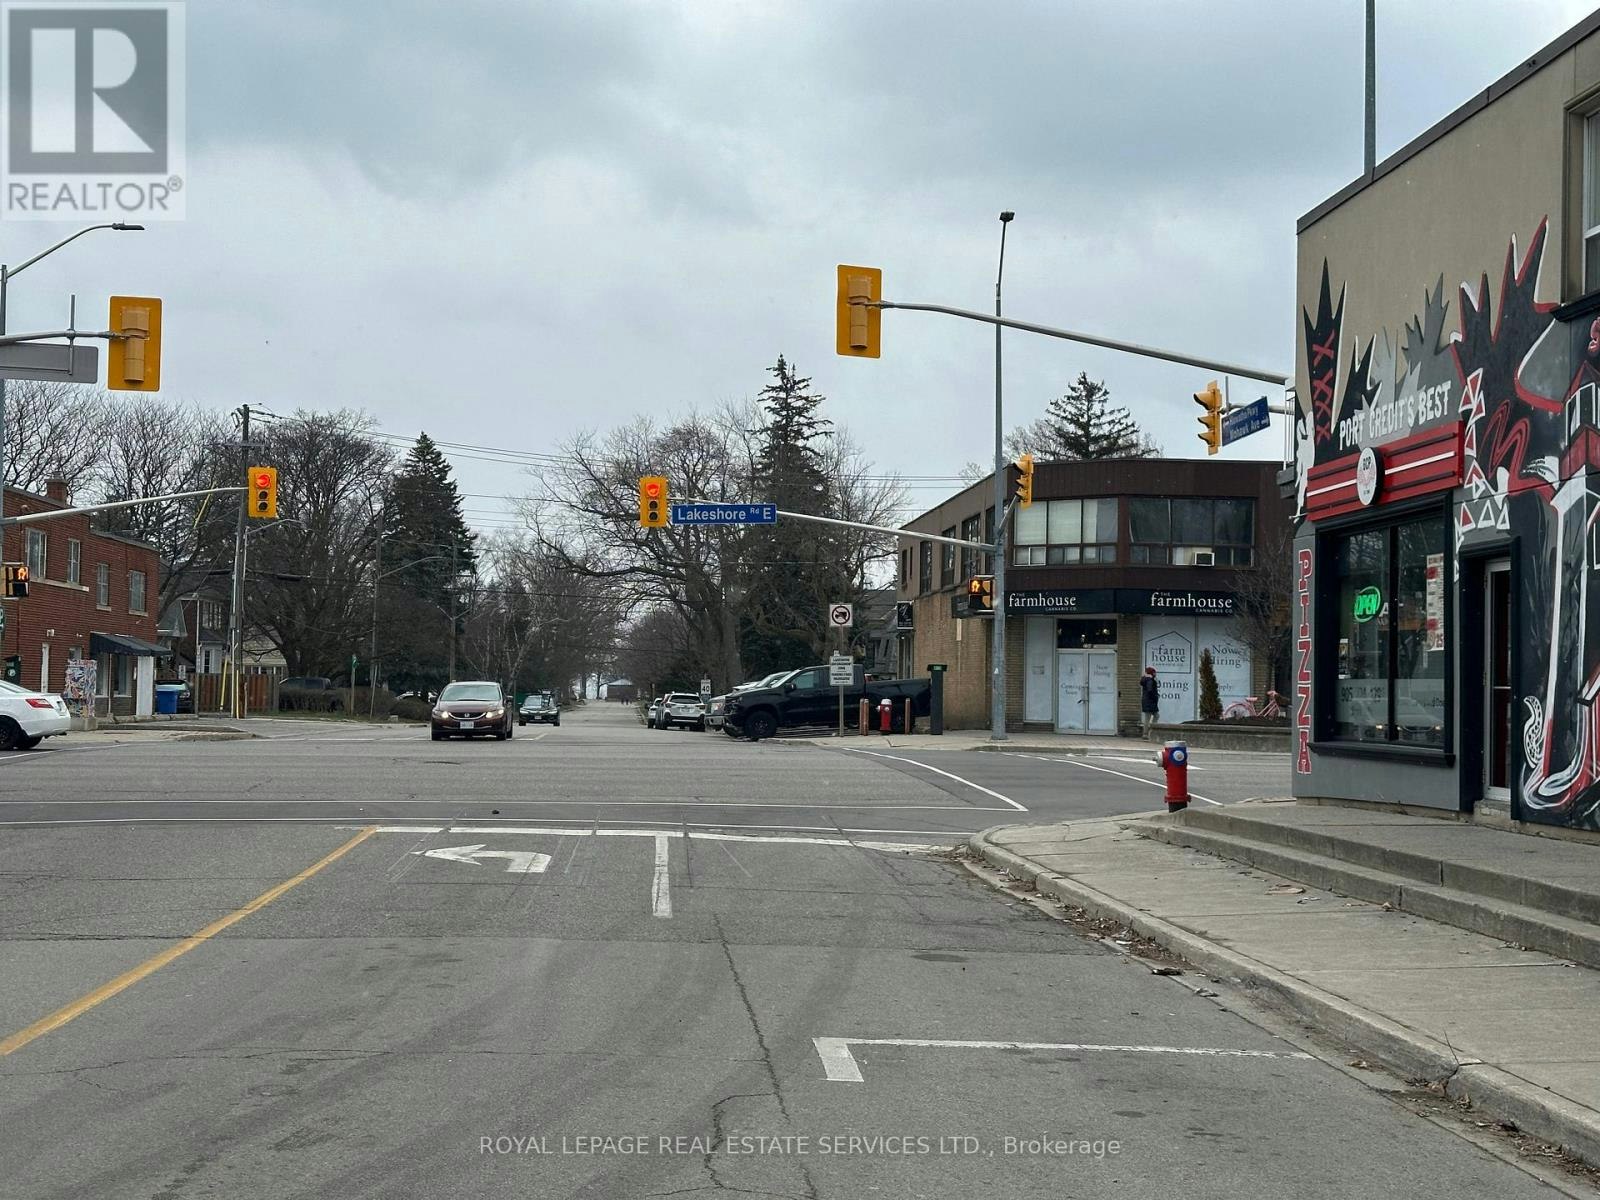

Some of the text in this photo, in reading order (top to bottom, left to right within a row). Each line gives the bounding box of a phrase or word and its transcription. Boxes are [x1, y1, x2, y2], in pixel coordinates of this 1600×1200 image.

[1339, 380, 1452, 451] PORT CREDIT'S BEST
[678, 507, 772, 521] Lakeshore Rd E
[1009, 593, 1076, 607] farmhouse
[1151, 592, 1233, 608] farmhouse
[1355, 594, 1378, 615] OPEN
[1152, 651, 1186, 663] house
[1158, 644, 1185, 656] farm
[1297, 549, 1312, 775] PIZZA
[1157, 680, 1189, 692] oming
